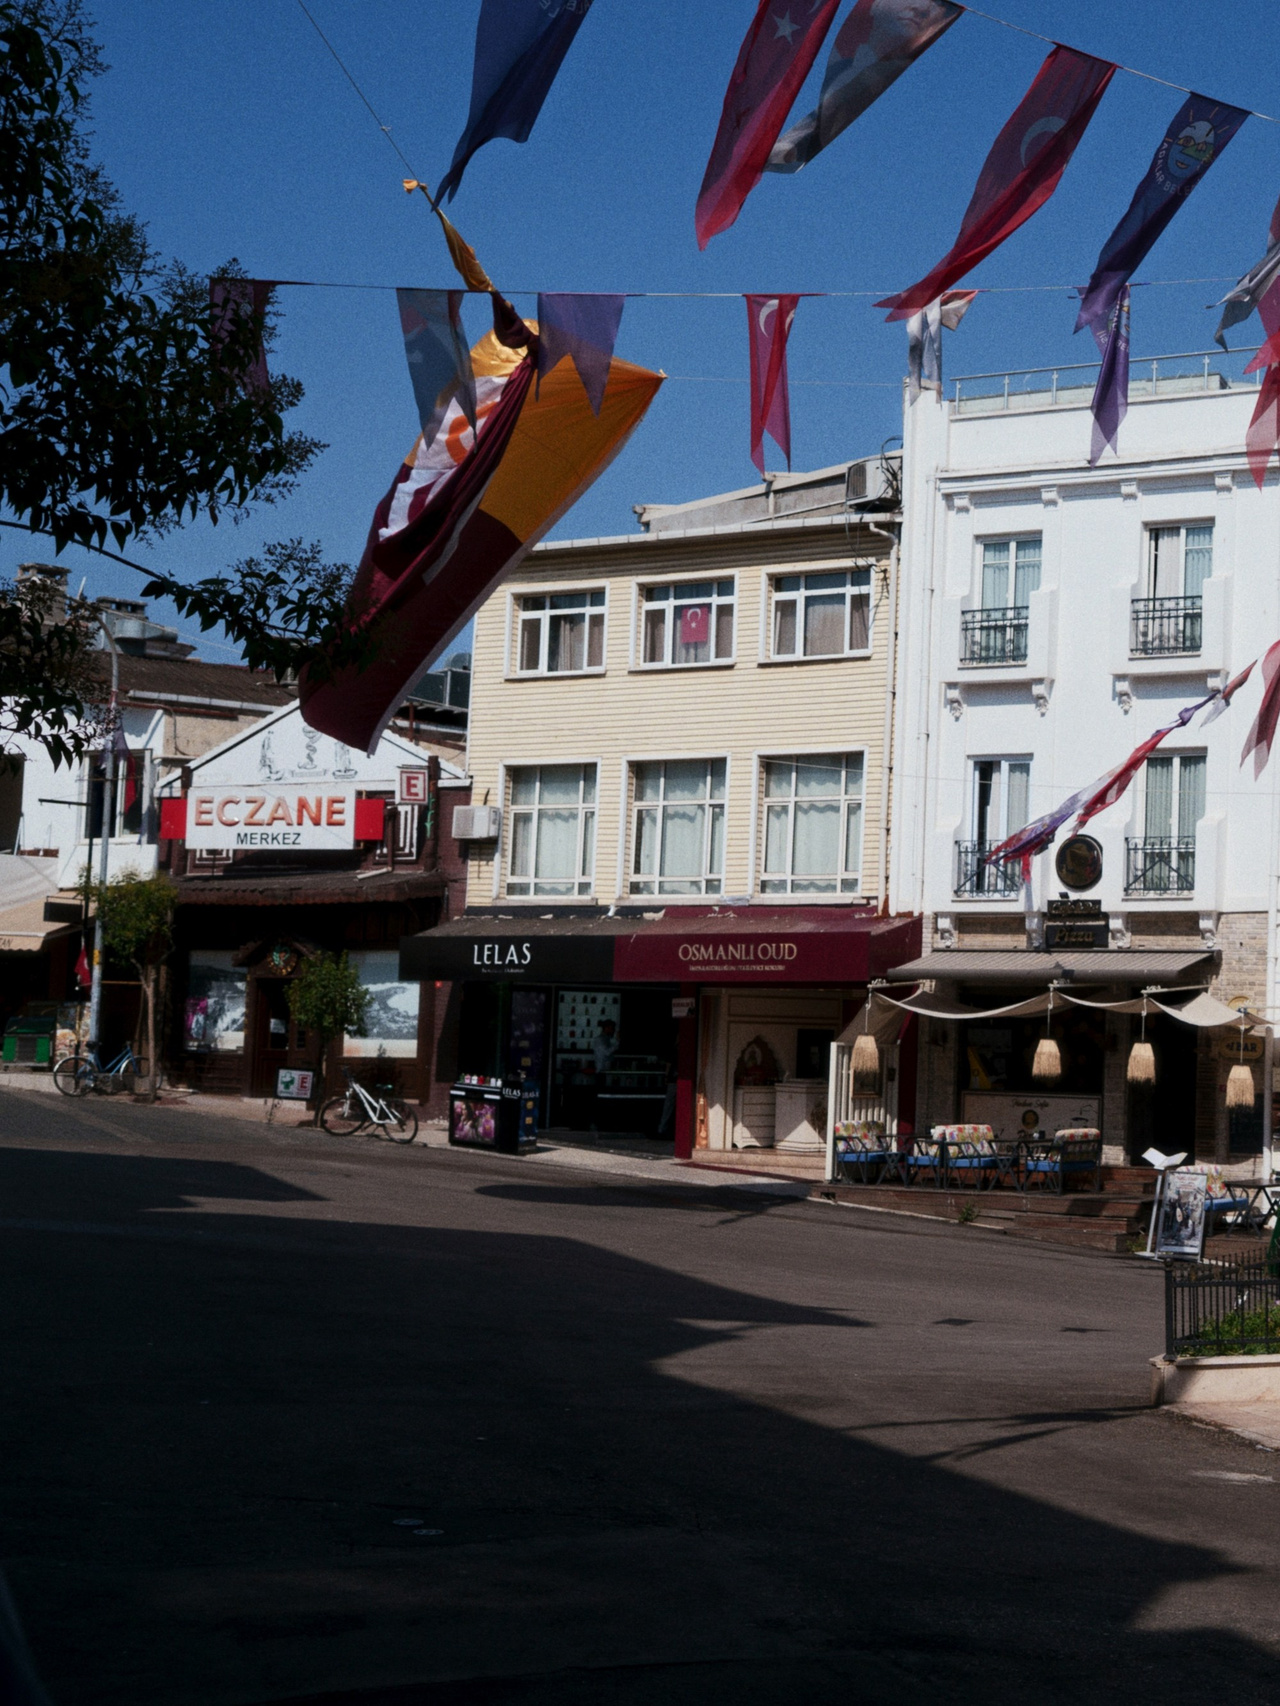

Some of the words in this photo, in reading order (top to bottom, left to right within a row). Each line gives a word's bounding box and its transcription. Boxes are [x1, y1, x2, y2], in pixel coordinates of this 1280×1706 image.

[405, 776, 420, 797] E
[194, 796, 347, 827] ECZANE
[236, 831, 302, 846] MERKEZ
[1054, 927, 1095, 943] Pizza
[473, 943, 532, 965] LELAS
[678, 943, 756, 961] OSMANLI
[758, 943, 797, 960] OUD
[1236, 1042, 1257, 1052] BAR
[502, 1087, 521, 1097] LELAS
